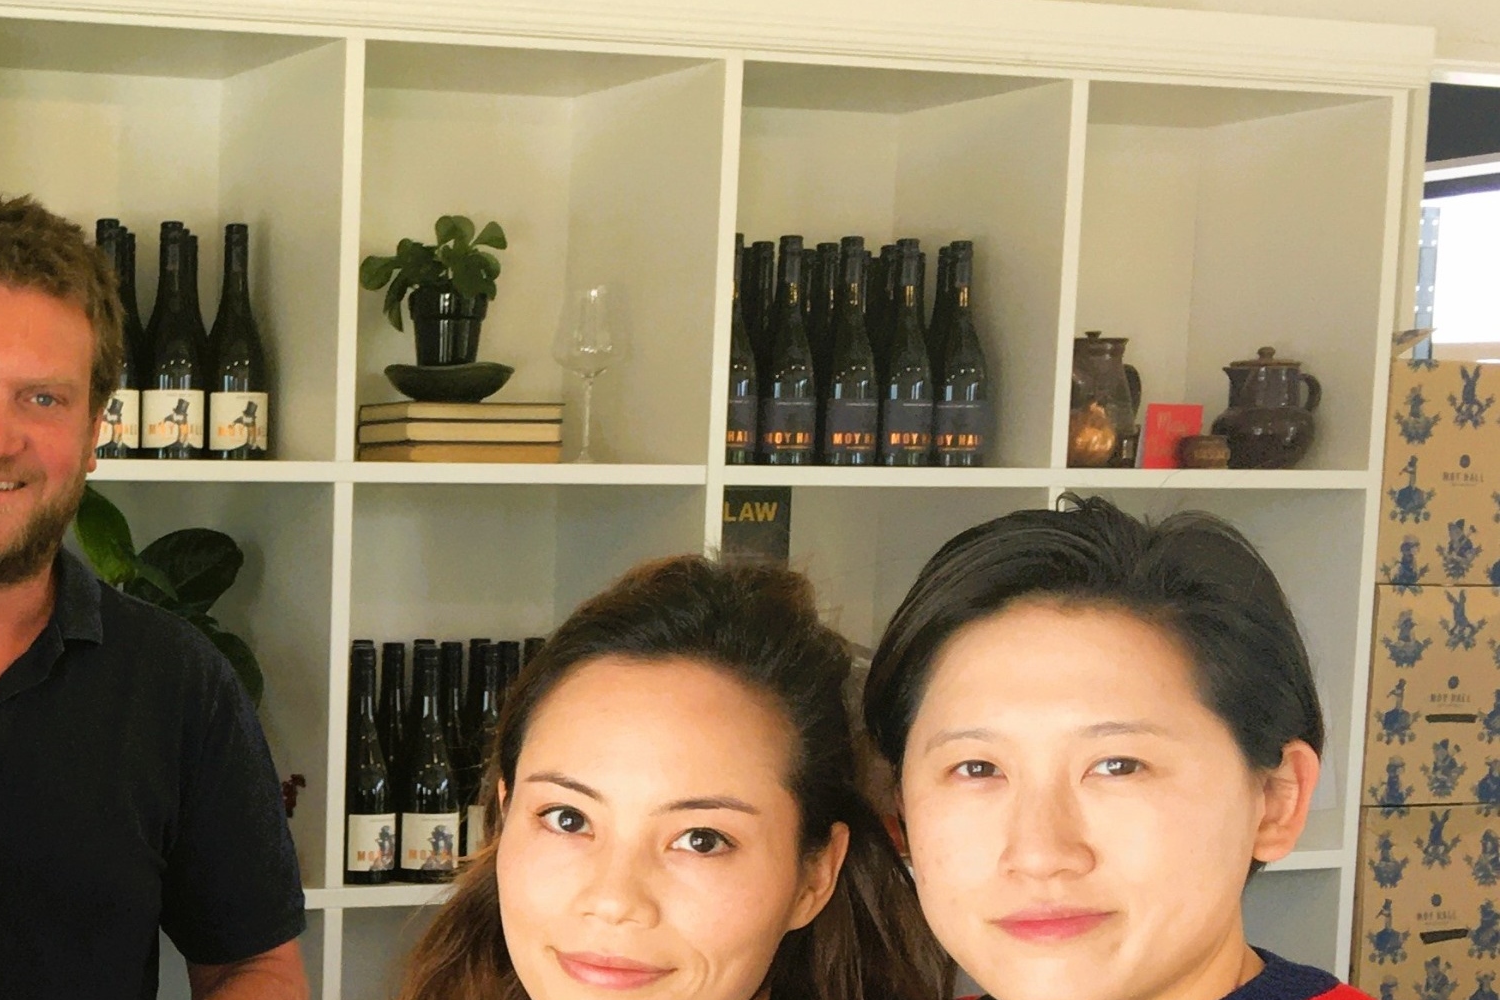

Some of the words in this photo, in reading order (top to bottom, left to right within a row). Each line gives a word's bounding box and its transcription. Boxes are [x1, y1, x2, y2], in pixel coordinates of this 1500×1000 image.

[832, 432, 861, 445] MOY
[890, 432, 919, 445] MOY
[958, 434, 980, 446] HAL
